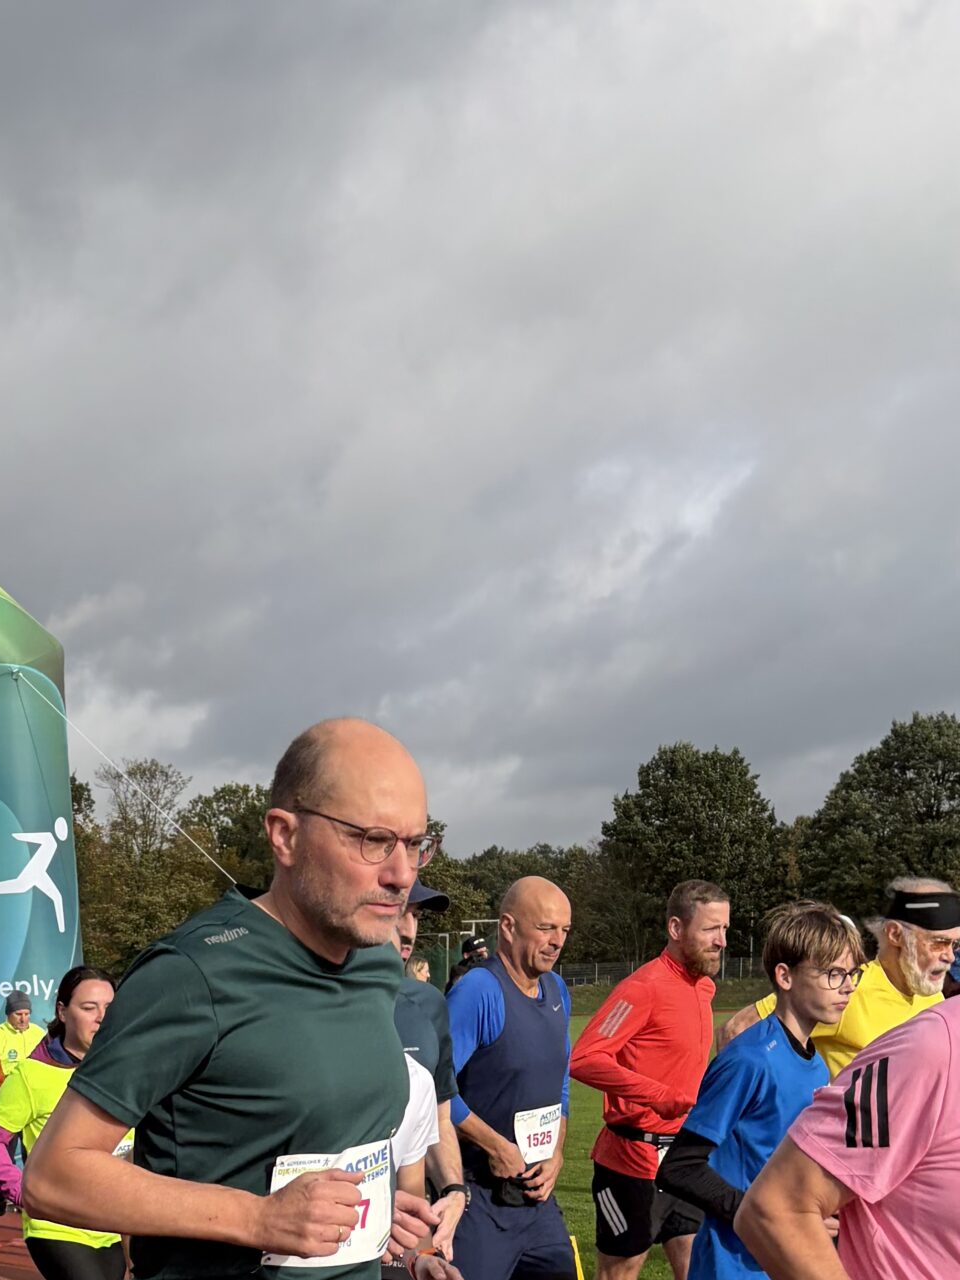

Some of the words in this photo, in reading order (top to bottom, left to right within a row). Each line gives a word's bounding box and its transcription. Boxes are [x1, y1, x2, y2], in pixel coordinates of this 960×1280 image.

[204, 927, 249, 945] newline
[526, 1130, 553, 1148] 1525
[360, 1165, 389, 1184] RTSHOP
